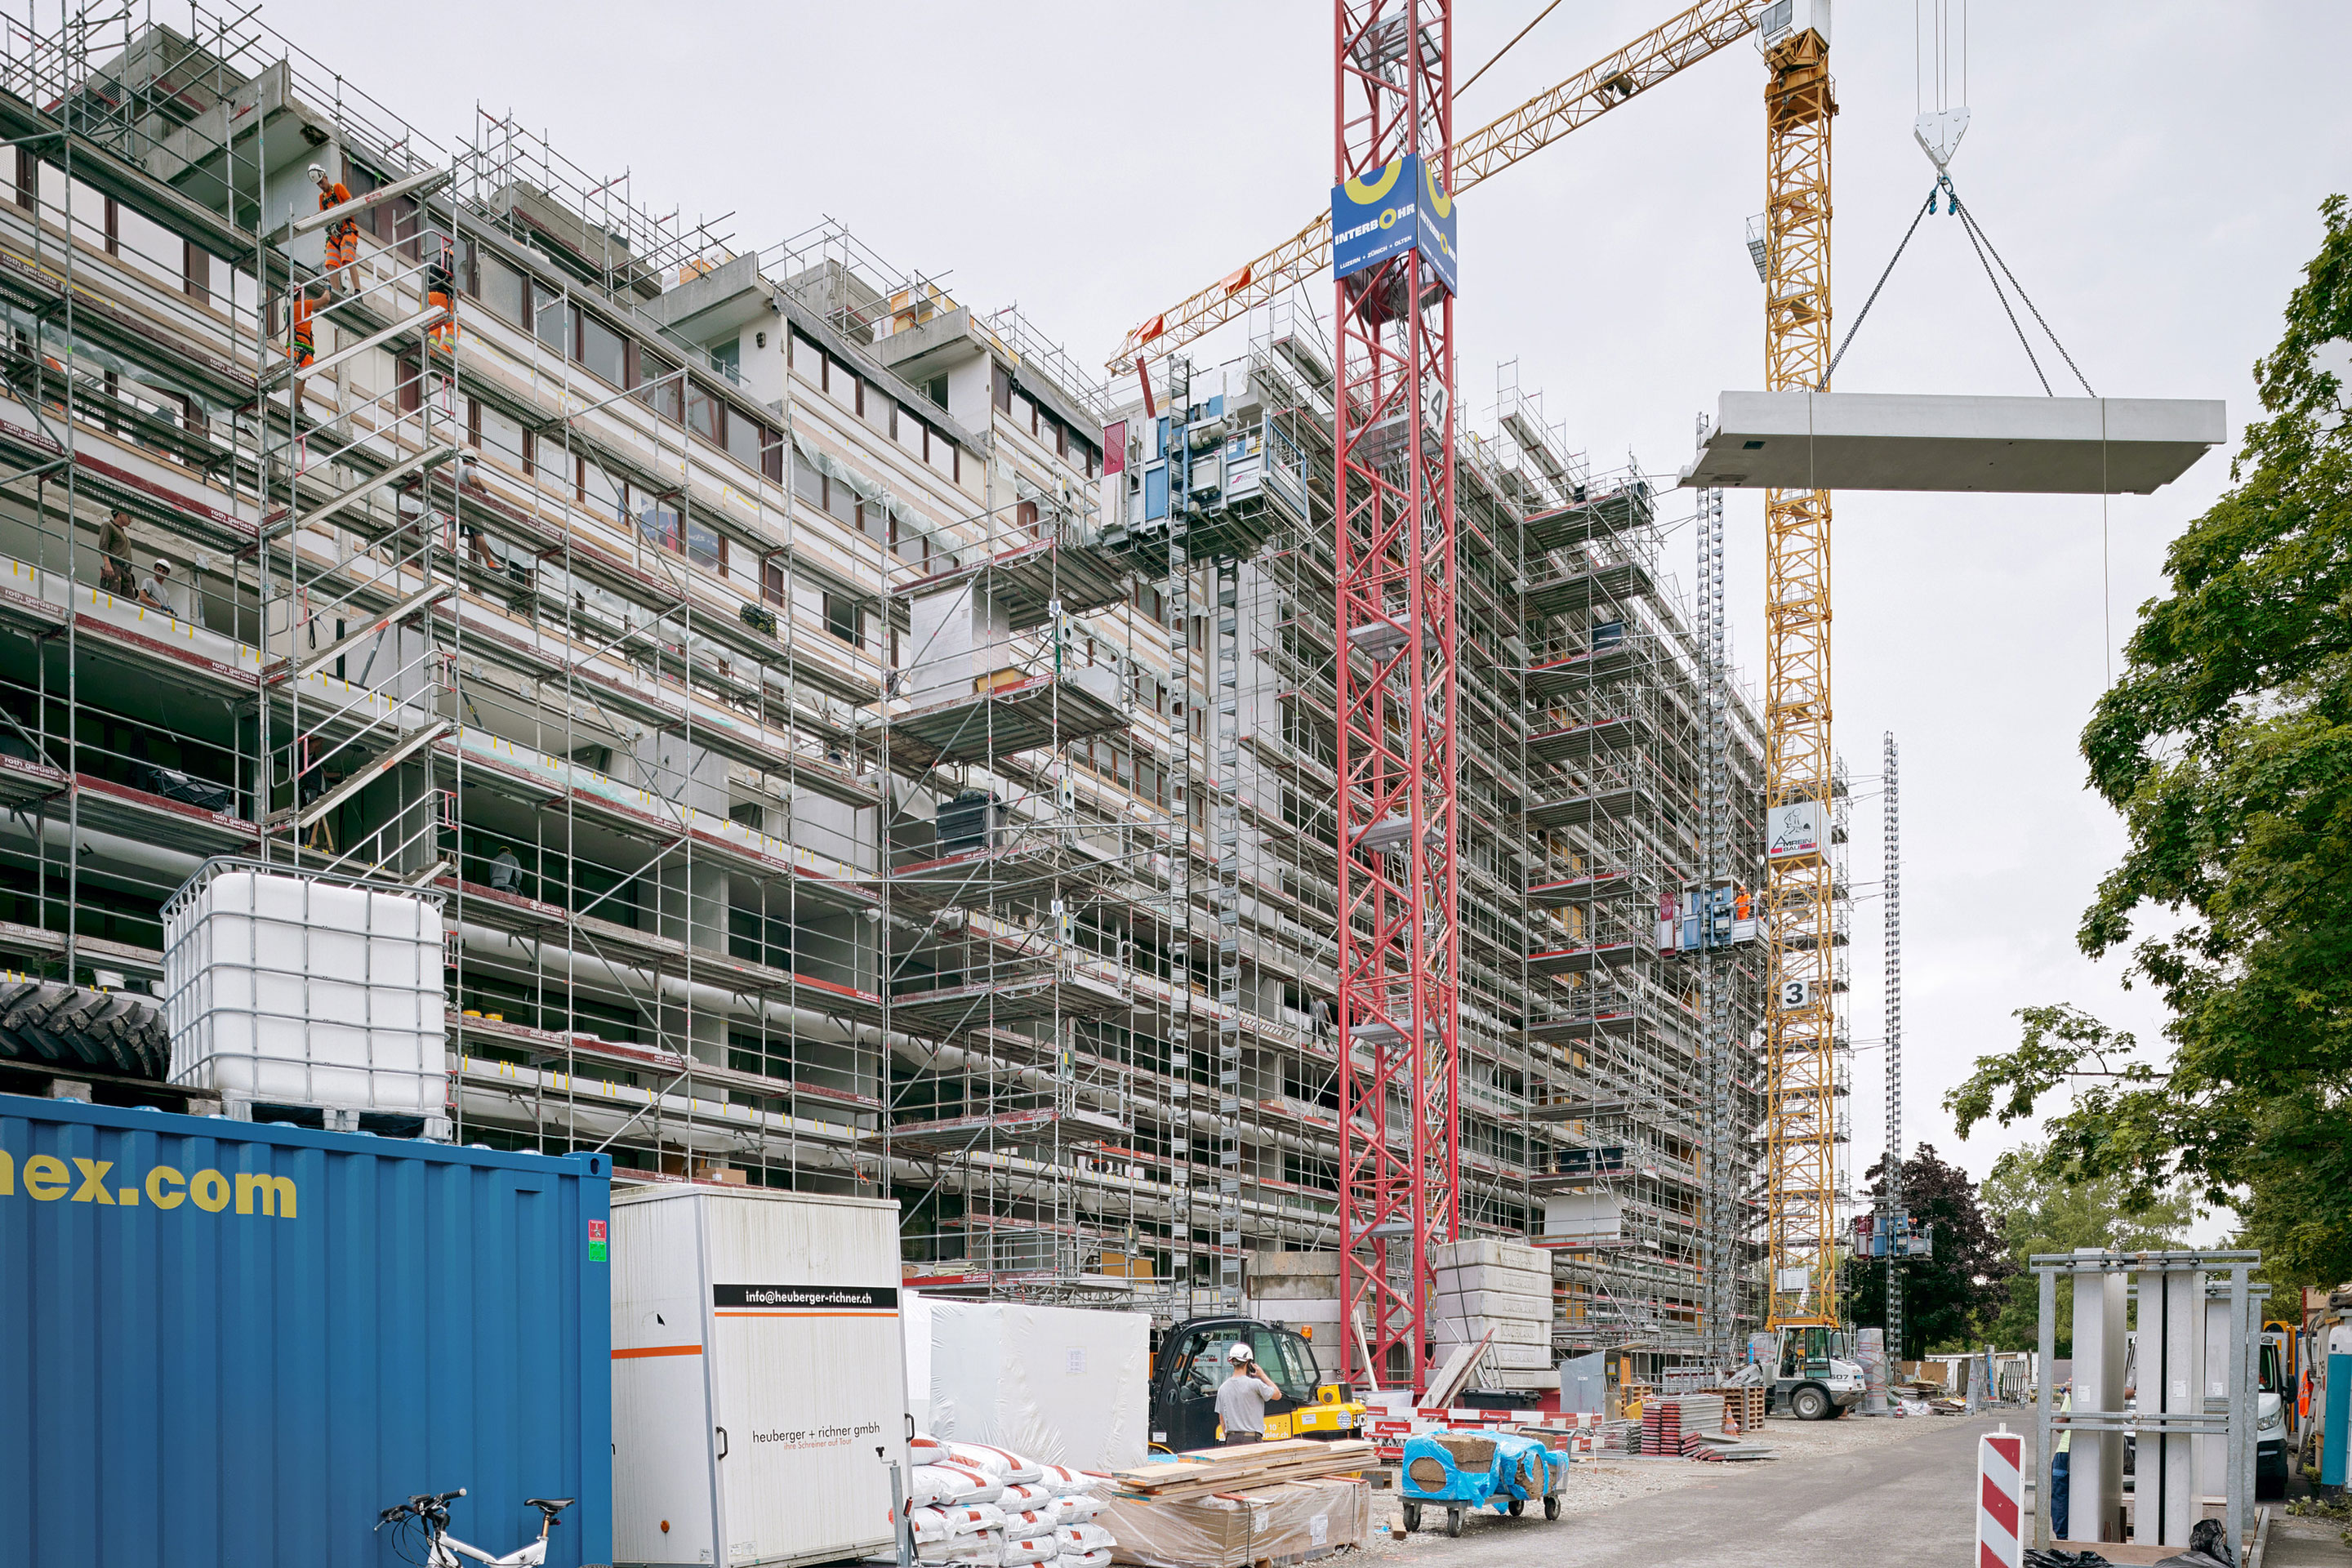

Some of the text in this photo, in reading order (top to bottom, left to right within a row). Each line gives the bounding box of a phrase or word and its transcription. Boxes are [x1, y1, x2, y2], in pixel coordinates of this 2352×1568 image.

[1334, 203, 1415, 246] INTERBOHR
[1339, 235, 1412, 270] LUZERN ZÜRICH OLTEN
[2, 254, 57, 286] roth gerüste
[210, 359, 255, 384] roth gerüste
[1431, 388, 1445, 428] 4
[3, 421, 57, 448] roth gerüste
[211, 510, 256, 532] roth gerüste
[5, 589, 59, 612] roth gerüste
[212, 662, 257, 681] roth gerüste
[5, 757, 59, 777] roth gerüste
[212, 813, 257, 831] roth gerüste
[1772, 835, 1812, 849] AMREIN
[1785, 983, 1803, 1004] 3
[746, 1289, 872, 1304] info@heuberger-richner.ch
[752, 1430, 805, 1444] heuberger
[818, 1425, 852, 1438] richner
[853, 1421, 880, 1437] gmbh
[798, 1439, 826, 1450] Schreiner
[828, 1437, 838, 1447] auf
[840, 1437, 853, 1446] Tour
